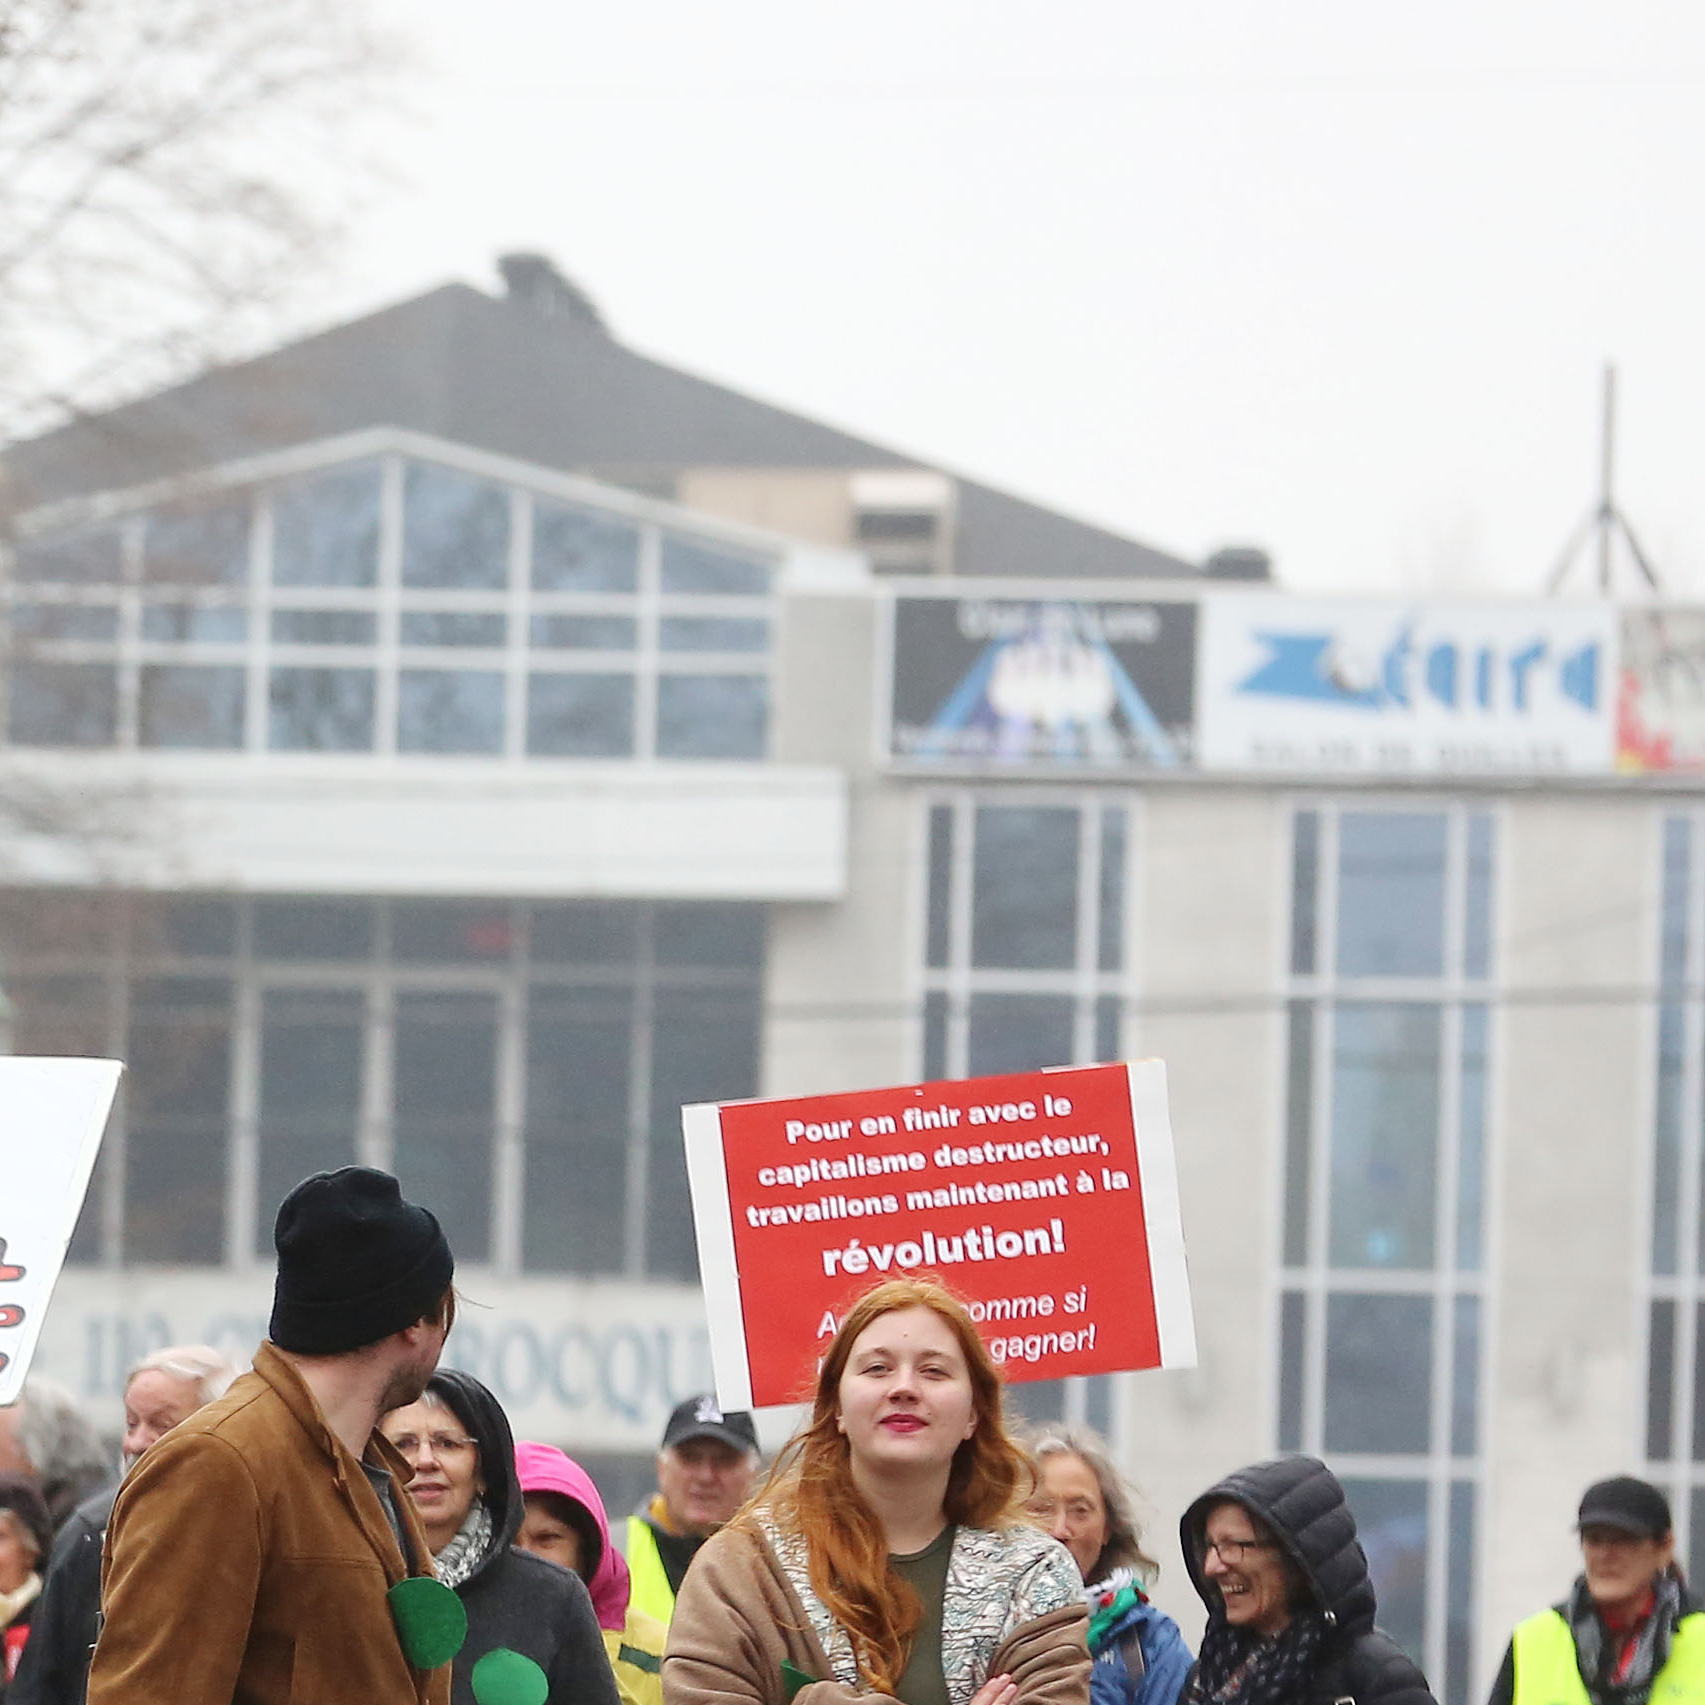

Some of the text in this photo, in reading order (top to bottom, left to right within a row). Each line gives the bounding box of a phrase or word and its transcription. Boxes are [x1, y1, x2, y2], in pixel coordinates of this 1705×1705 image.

[785, 1093, 1072, 1145] Pour en finir avec le
[757, 1132, 1110, 1189] capitalisme destructeur,
[745, 1165, 1130, 1228] travaillons maintenant à la
[822, 1218, 1067, 1277] révolution!
[1063, 1283, 1088, 1314] si
[990, 1322, 1096, 1366] gagner!
